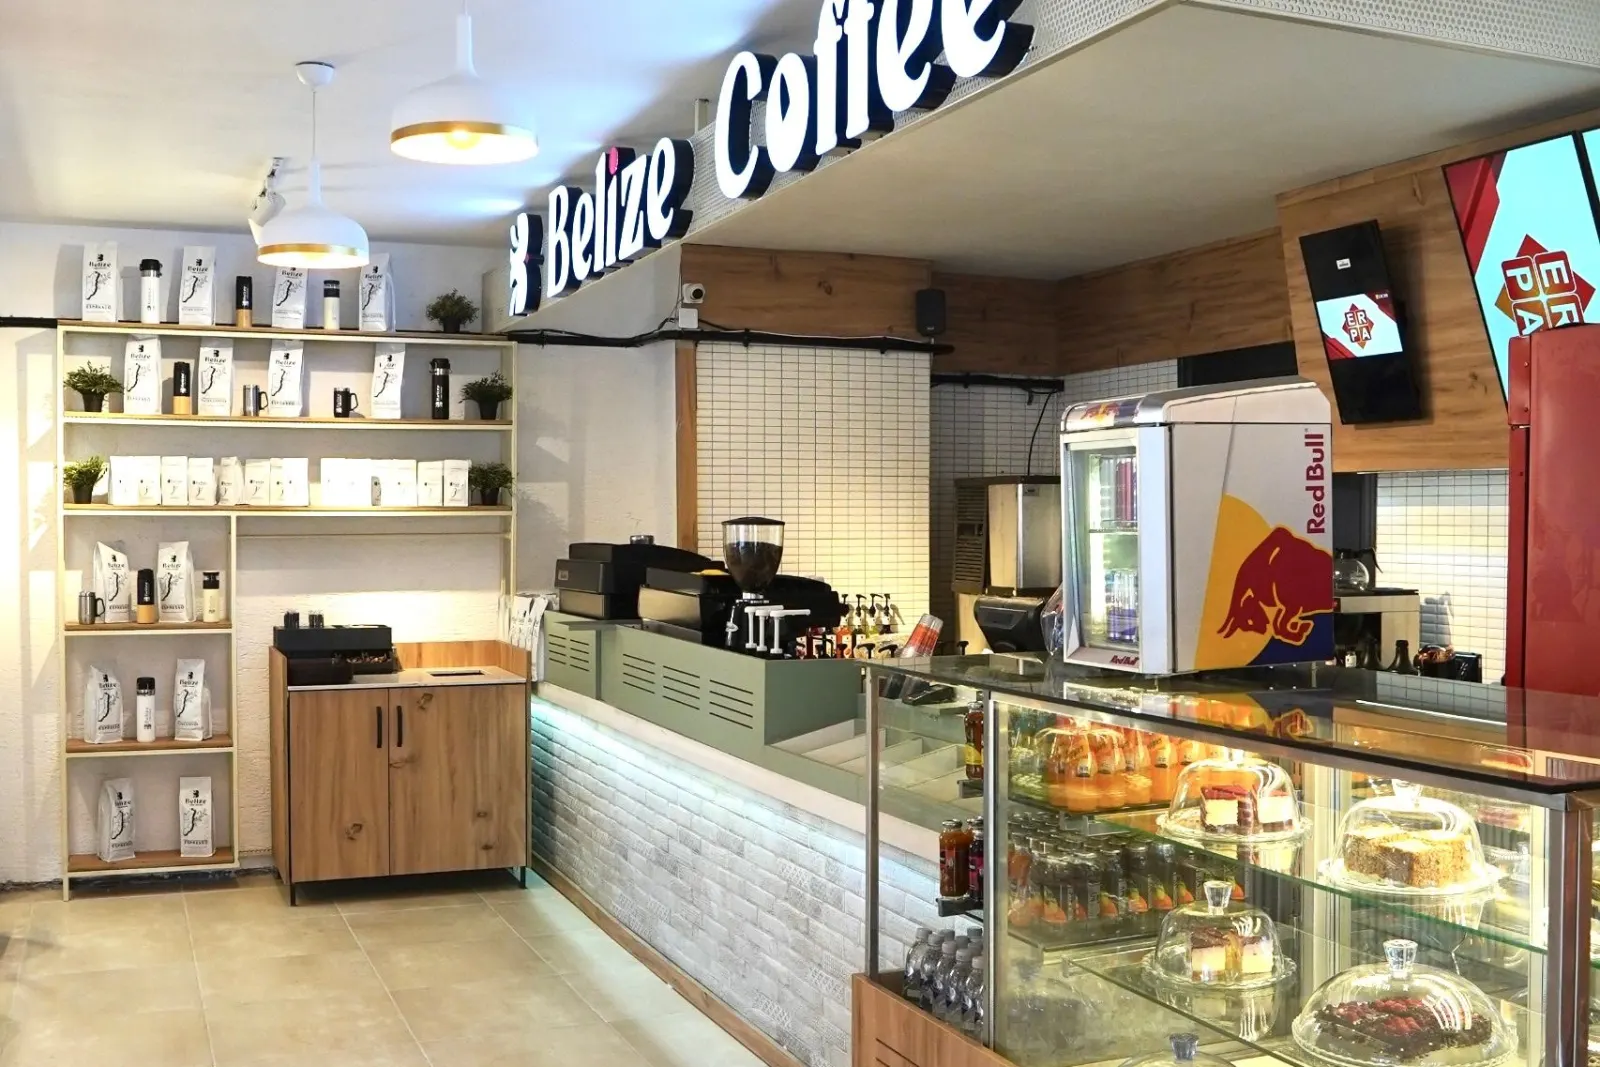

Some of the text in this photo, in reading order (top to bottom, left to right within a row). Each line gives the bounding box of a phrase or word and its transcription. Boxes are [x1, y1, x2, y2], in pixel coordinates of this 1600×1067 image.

[547, 0, 1007, 298] Belize Coffee
[1304, 433, 1325, 534] Red Bull
